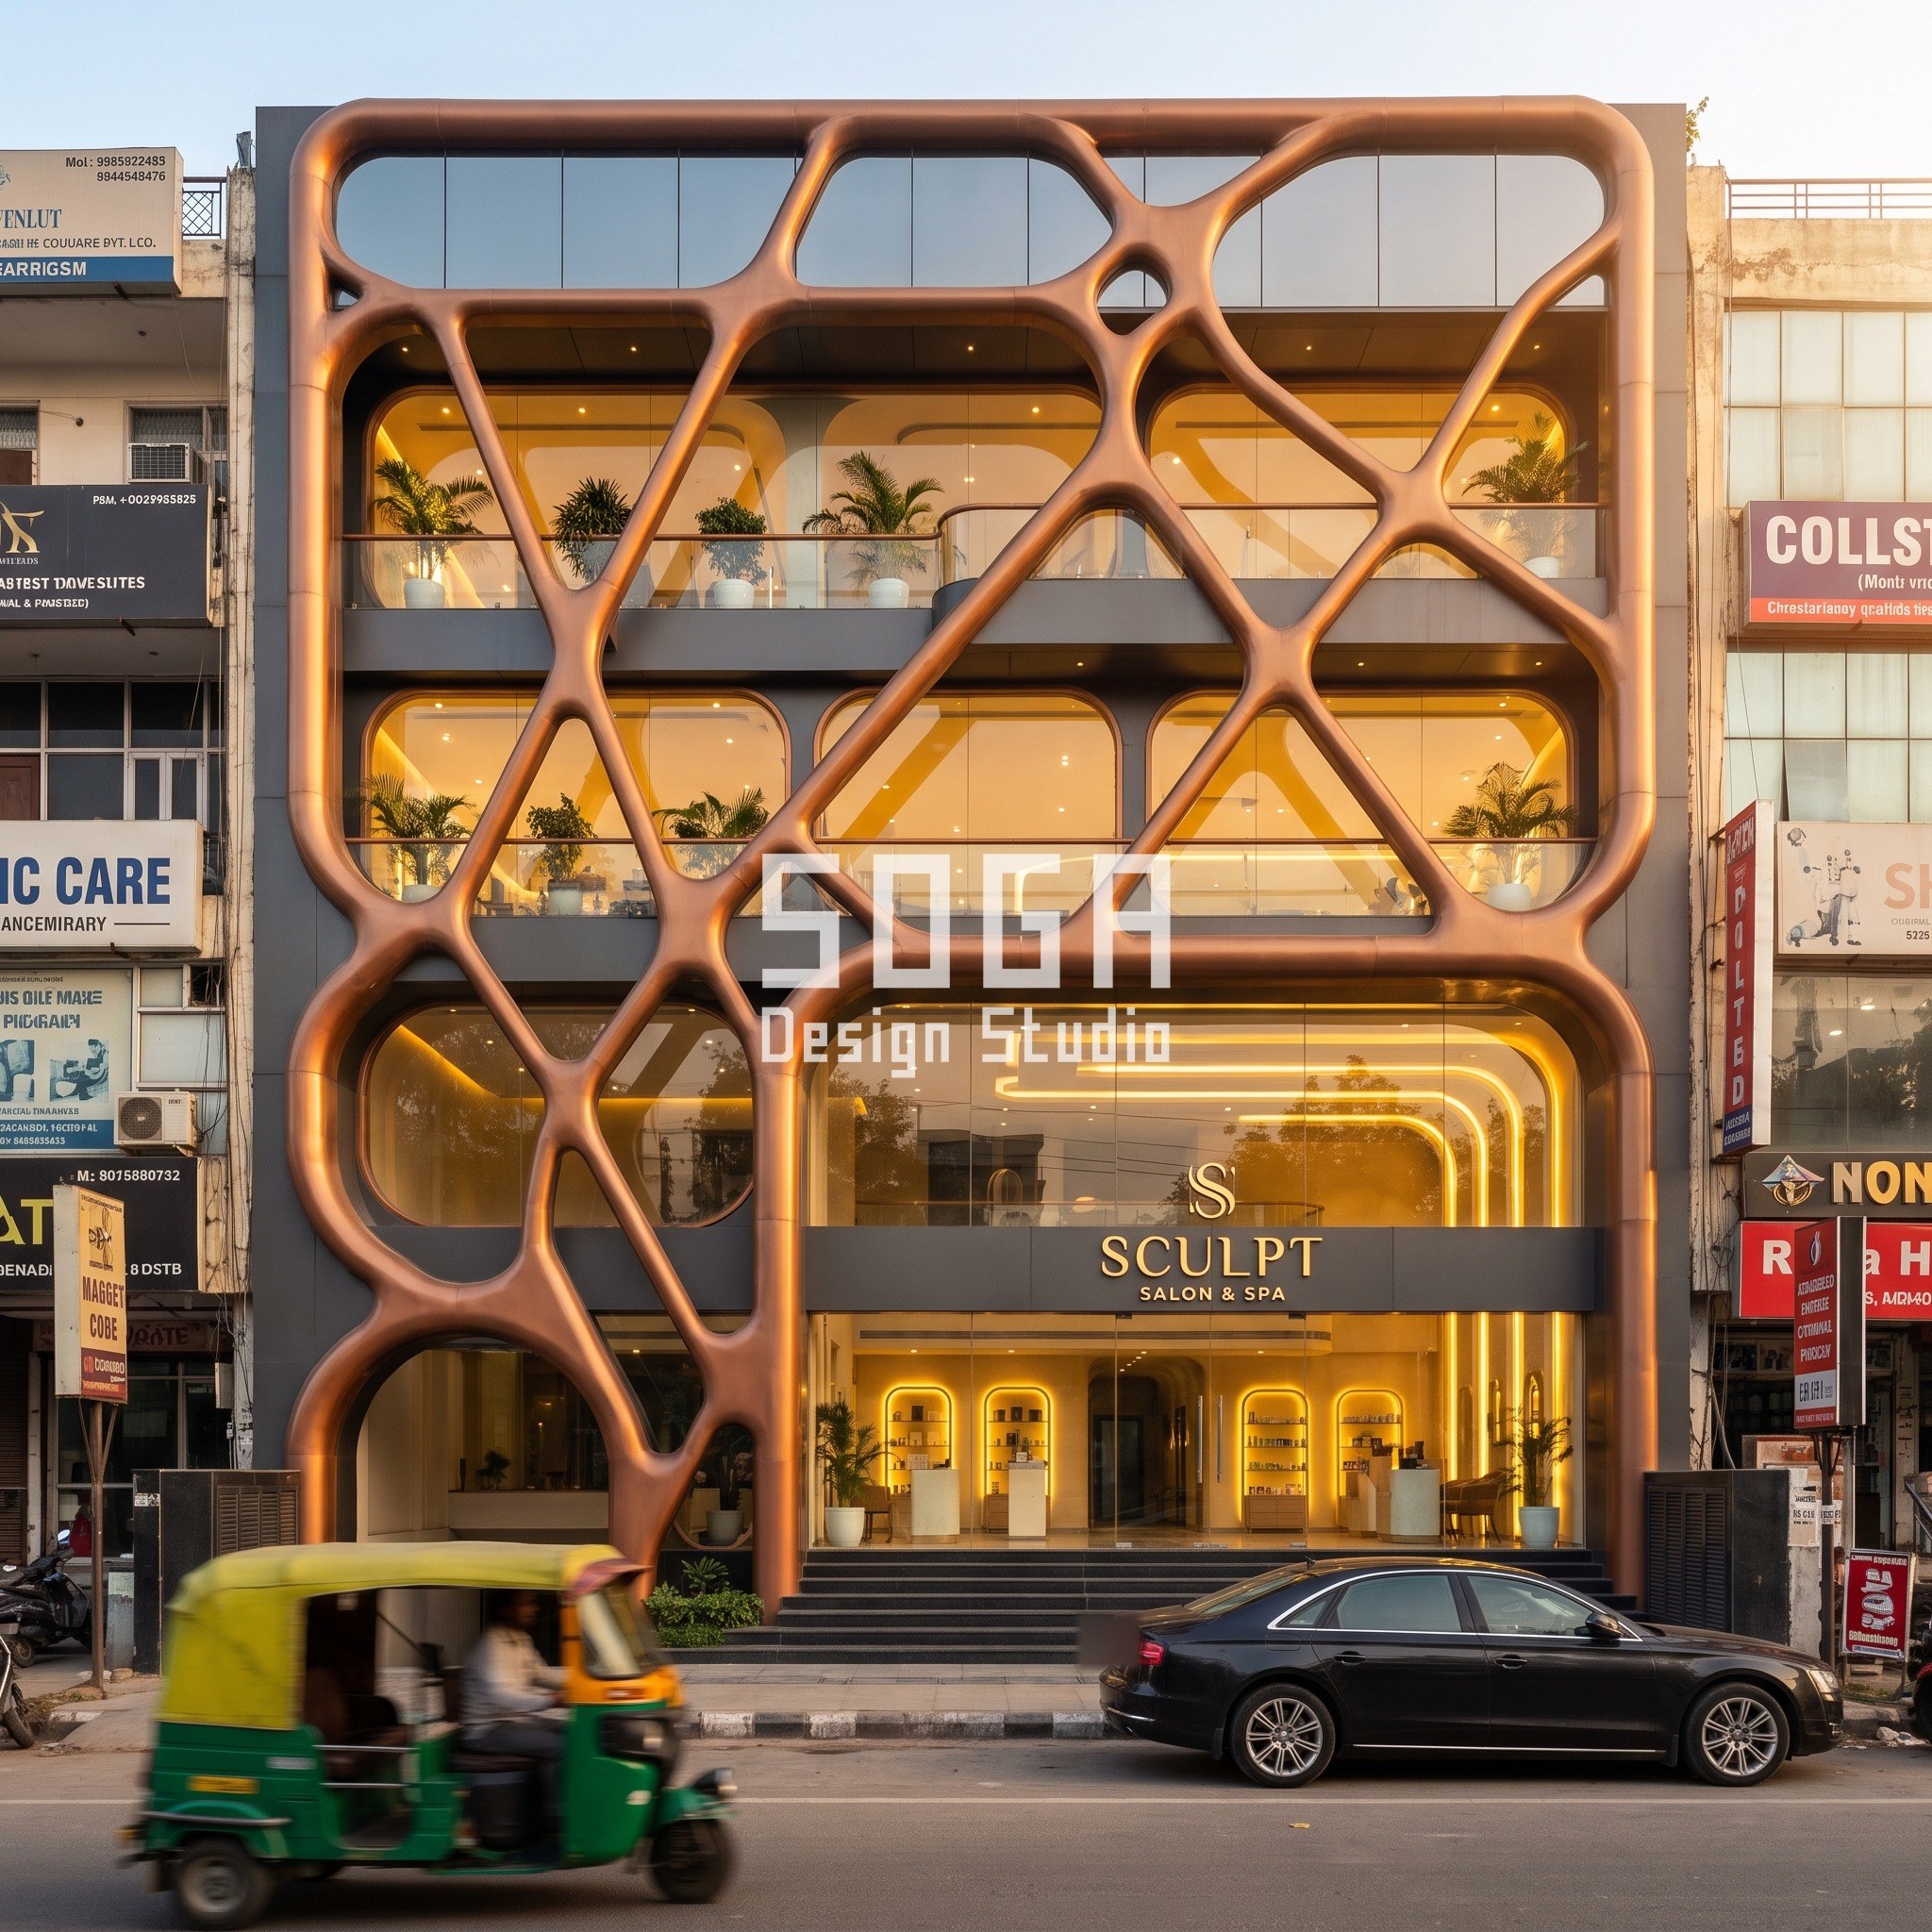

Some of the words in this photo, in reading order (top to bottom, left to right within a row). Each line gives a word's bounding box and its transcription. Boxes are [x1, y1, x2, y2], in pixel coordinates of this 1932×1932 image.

[0, 208, 62, 228] ENLUT
[0, 261, 87, 276] ARRIGSM
[56, 857, 171, 905] CARE
[1, 916, 107, 931] ANCEMIRARY
[1101, 1235, 1324, 1277] SCULPT
[1140, 1287, 1212, 1301] SALON
[1222, 1287, 1235, 1301] &
[1244, 1287, 1285, 1301] SPA
